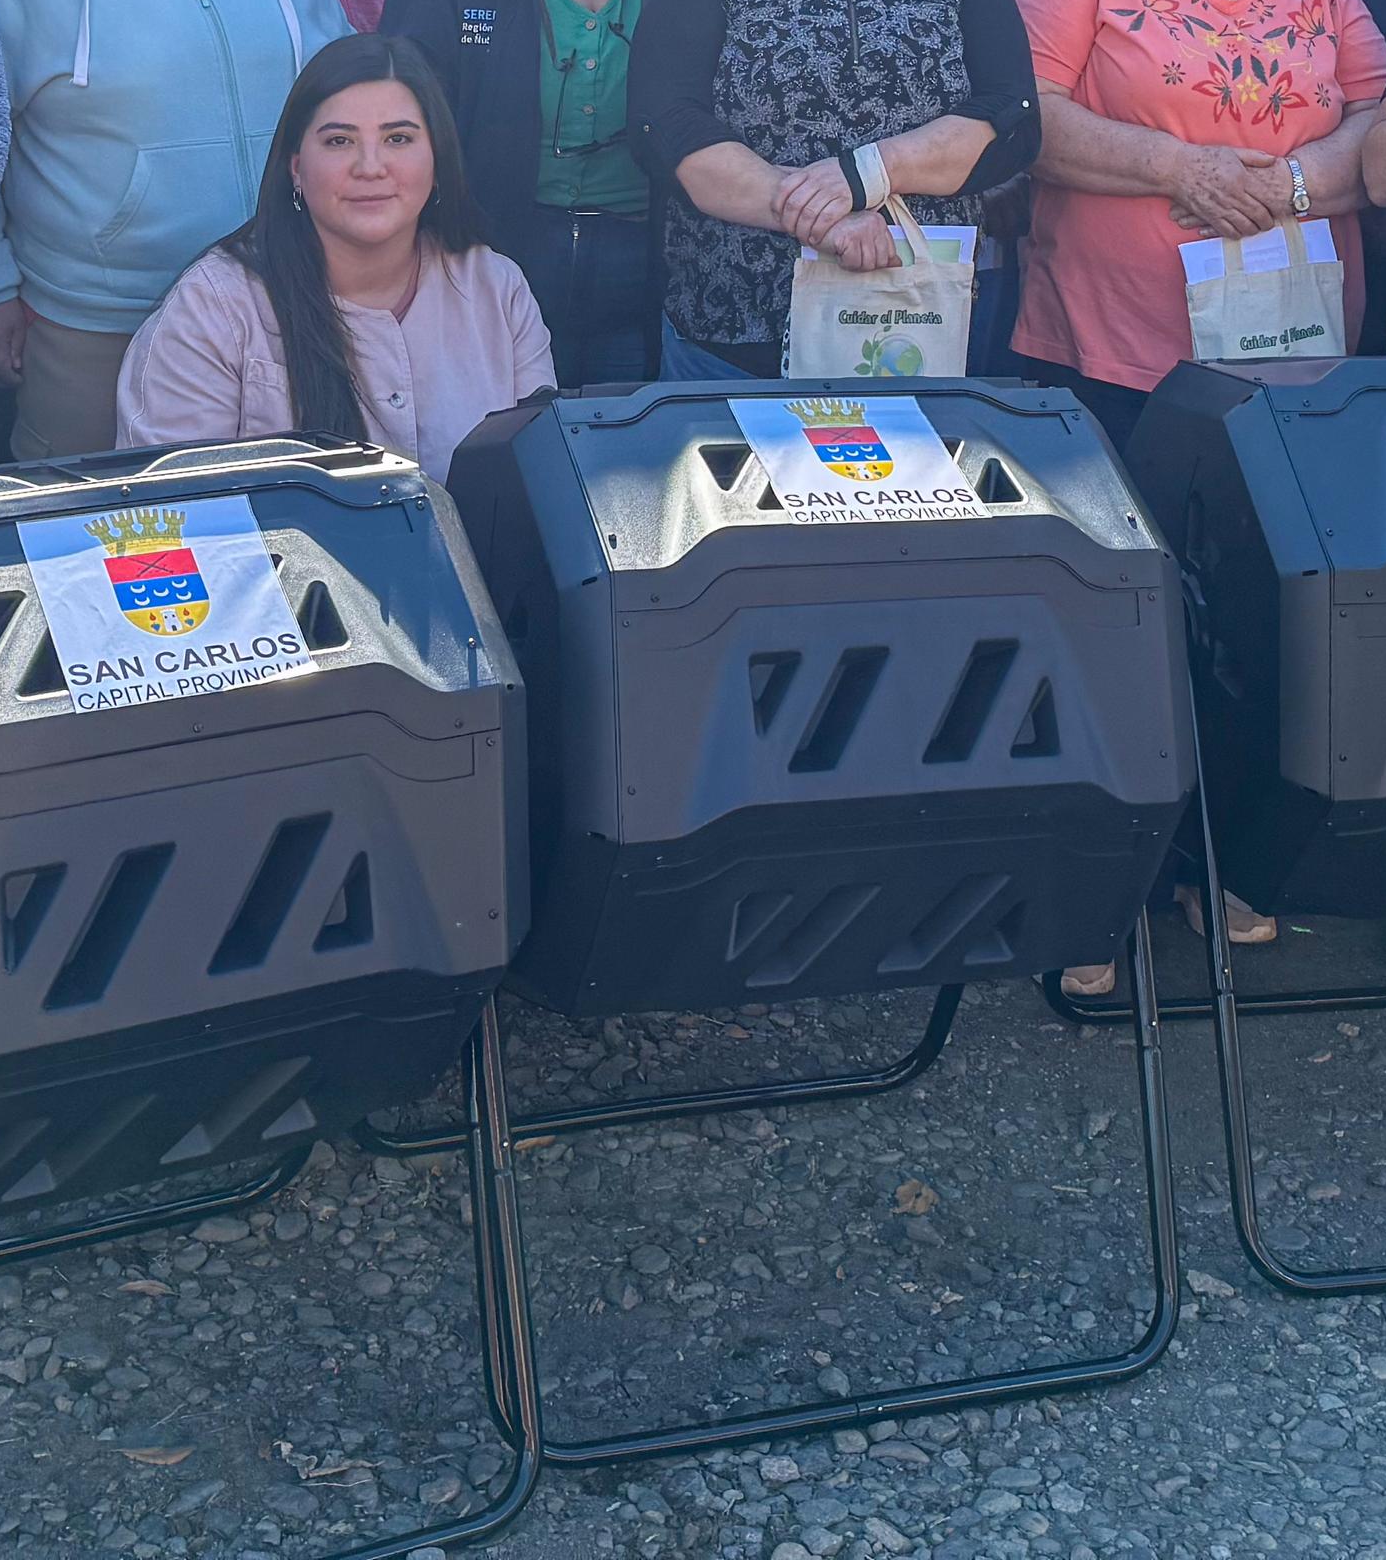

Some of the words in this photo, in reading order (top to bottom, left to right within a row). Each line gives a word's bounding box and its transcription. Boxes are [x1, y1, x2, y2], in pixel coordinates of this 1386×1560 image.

[838, 310, 878, 325] Cuidar
[881, 310, 892, 324] el
[894, 310, 943, 324] Planeta
[1240, 334, 1277, 351] Cuidar
[784, 491, 847, 508] SAN
[854, 488, 974, 505] CARLOS
[795, 509, 872, 523] CAPITAL
[874, 506, 986, 521] PROVINCIAL
[68, 655, 145, 686] SAN
[155, 633, 301, 673] CARLOS
[77, 681, 174, 710] CAPITAL
